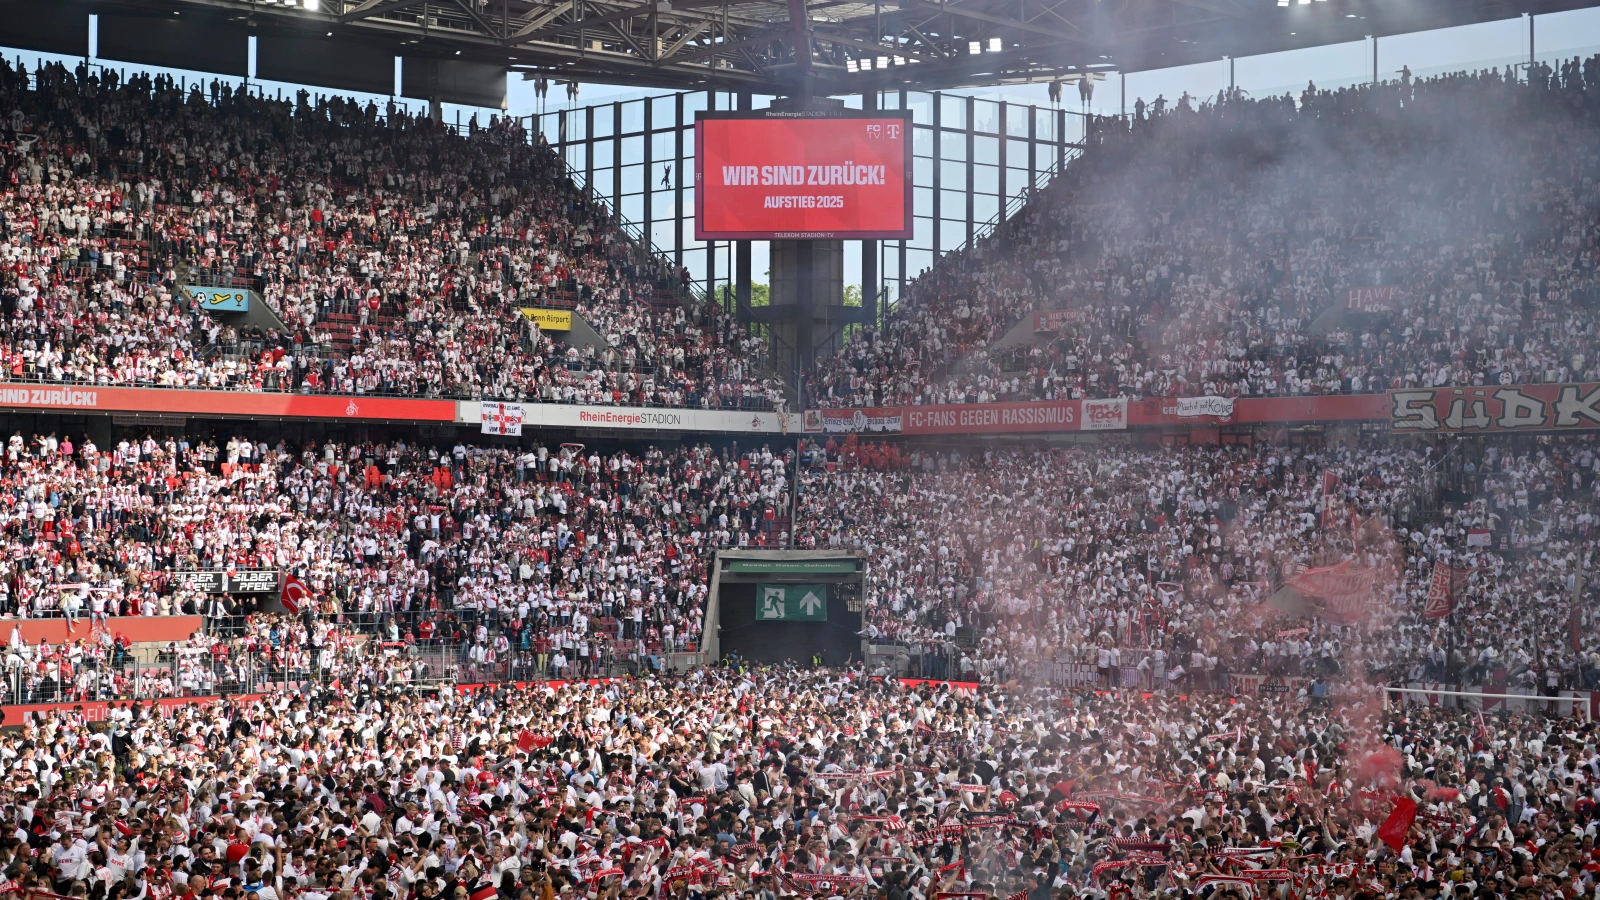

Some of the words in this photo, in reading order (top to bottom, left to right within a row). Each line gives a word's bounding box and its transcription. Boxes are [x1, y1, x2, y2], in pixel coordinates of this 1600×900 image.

[866, 124, 881, 132] FC
[722, 165, 761, 186] WIR
[761, 165, 805, 186] SIND
[807, 161, 885, 186] ZURÜCK!
[763, 195, 816, 209] AUFSTIEG
[816, 195, 844, 209] 2025
[546, 314, 570, 325] Airport
[31, 387, 97, 406] ZURÜCK!
[579, 411, 681, 425] RheinEnergieSTADION
[909, 410, 957, 428] FC-FANS
[960, 409, 998, 427] GEGEN
[1001, 406, 1073, 425] RASSISMUS
[232, 573, 273, 582] SILBER
[239, 582, 270, 591] PFEIL
